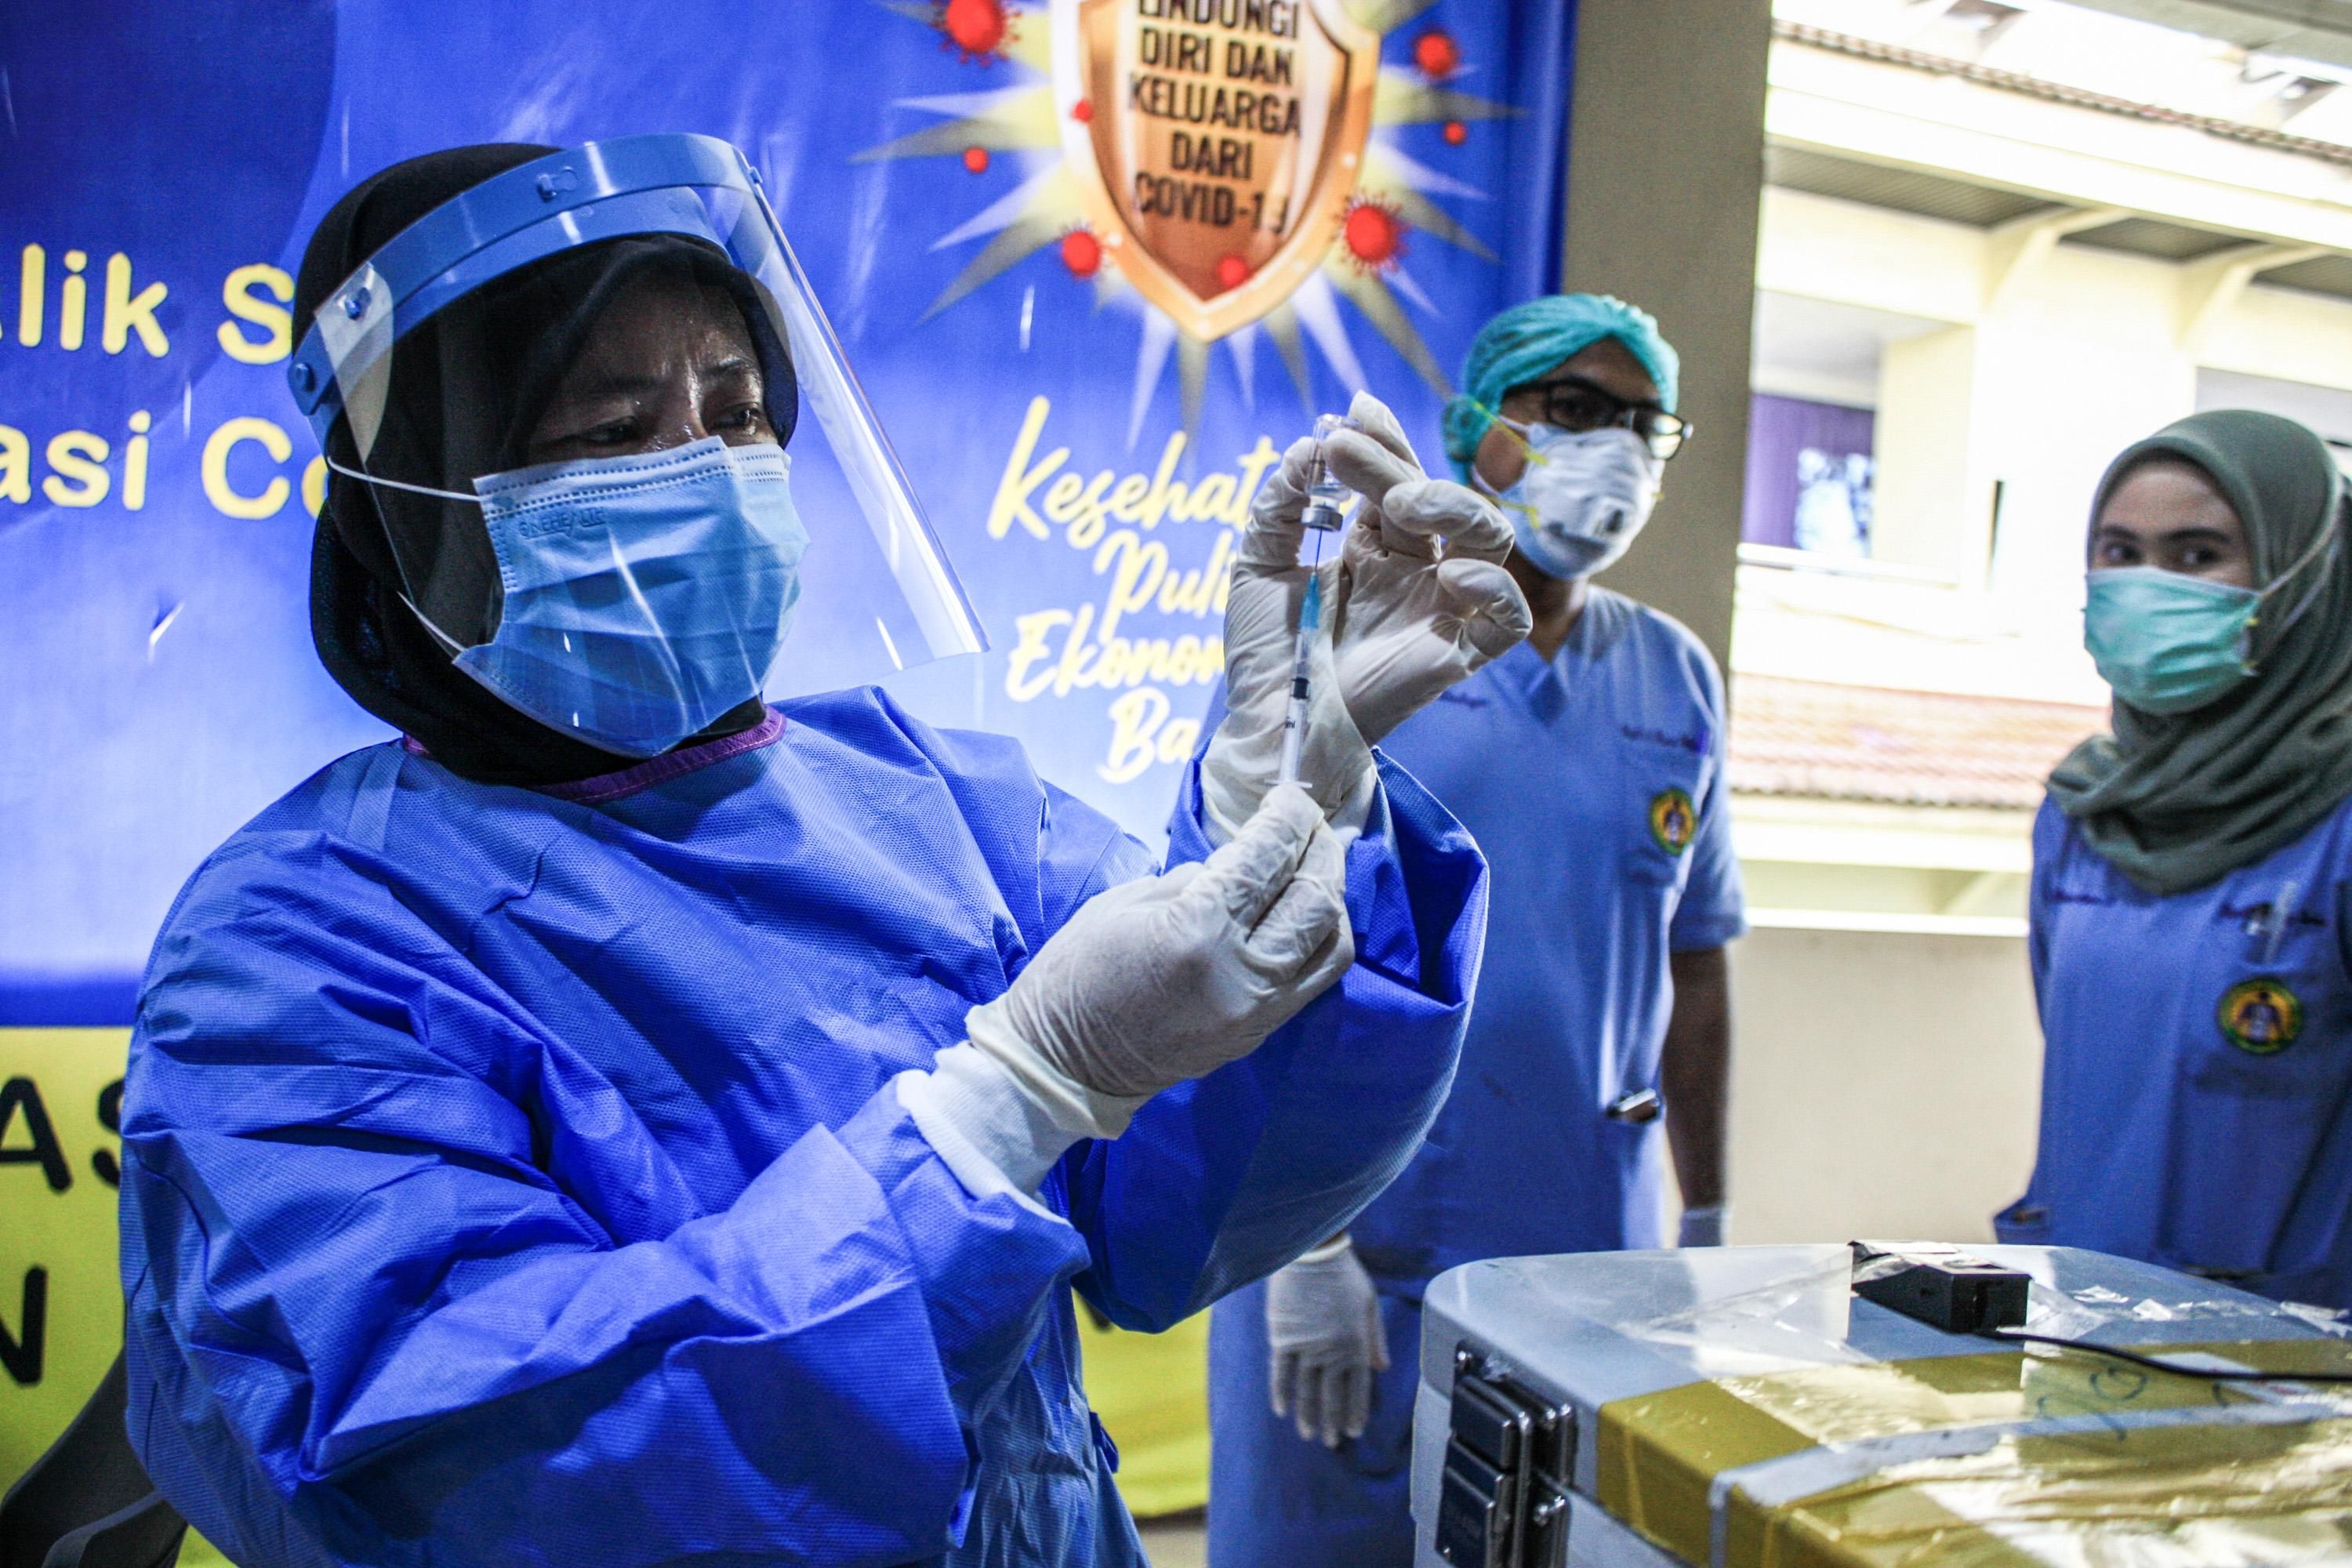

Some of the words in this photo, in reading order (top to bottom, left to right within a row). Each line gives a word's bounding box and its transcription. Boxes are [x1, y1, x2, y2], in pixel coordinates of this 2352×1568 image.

[1141, 27, 1211, 74] DIRI
[1225, 40, 1293, 85] DAN
[1129, 72, 1301, 137] KELUARGA
[1171, 132, 1252, 180] DARI
[0, 242, 169, 358] lik
